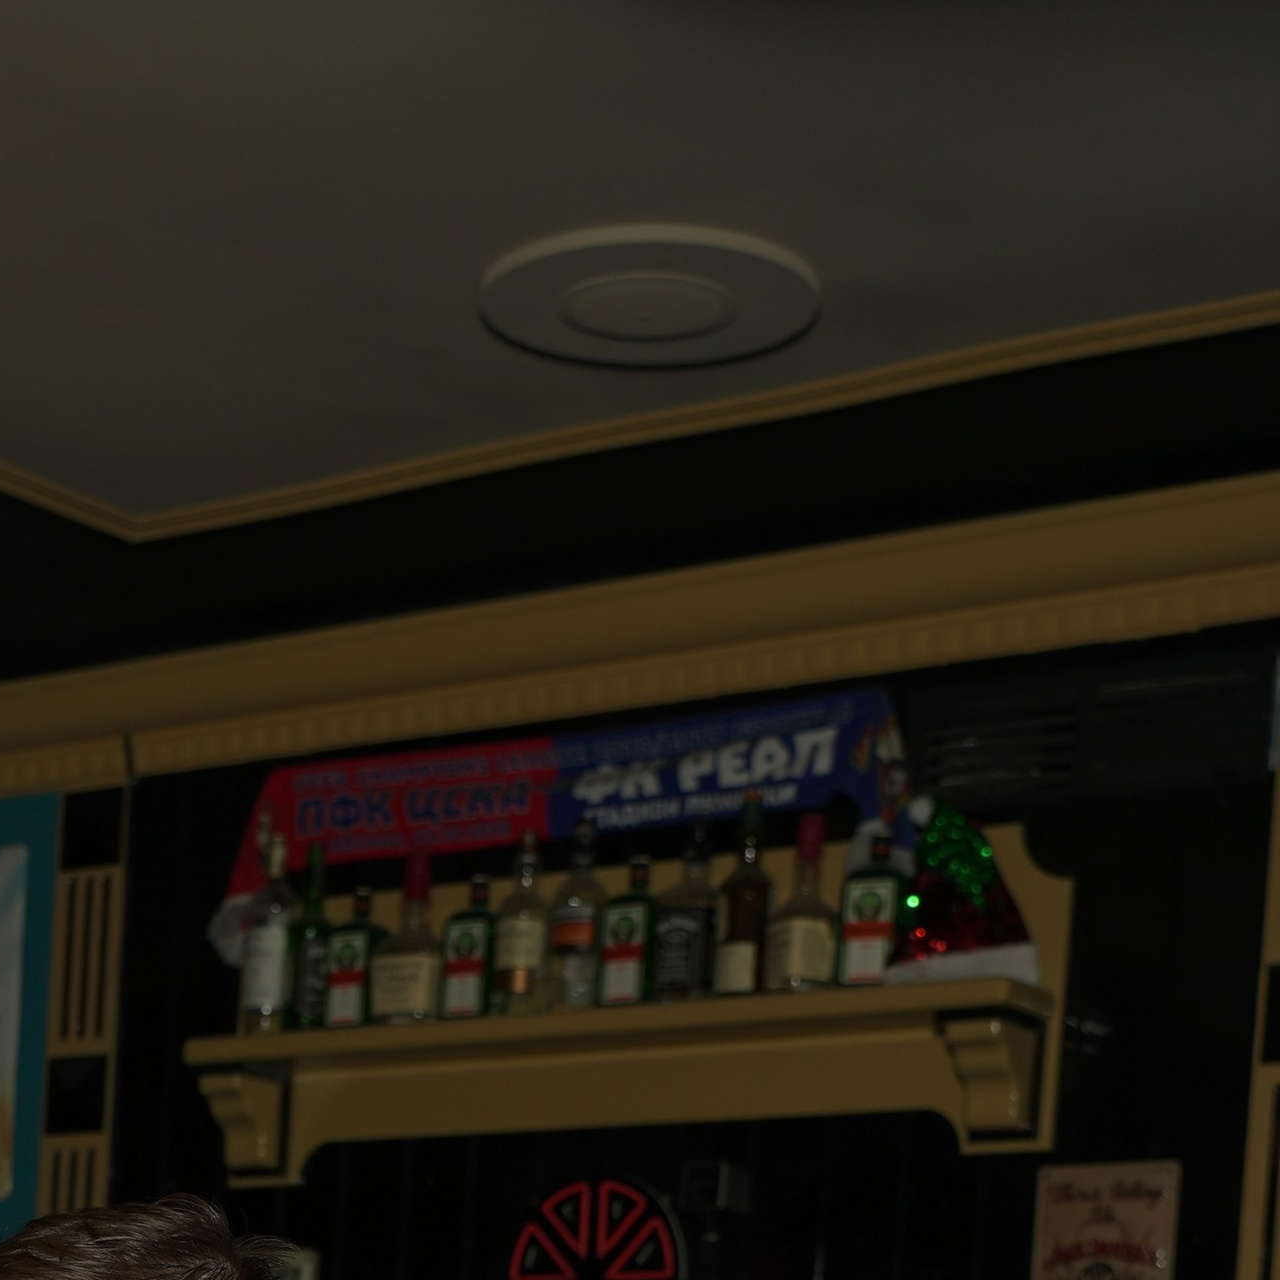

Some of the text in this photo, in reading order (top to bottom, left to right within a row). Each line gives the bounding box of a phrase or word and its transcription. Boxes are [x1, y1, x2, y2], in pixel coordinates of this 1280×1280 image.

[675, 726, 840, 794] РЕАЛ
[295, 790, 395, 840] ПФК
[406, 780, 532, 827] ЦСКА
